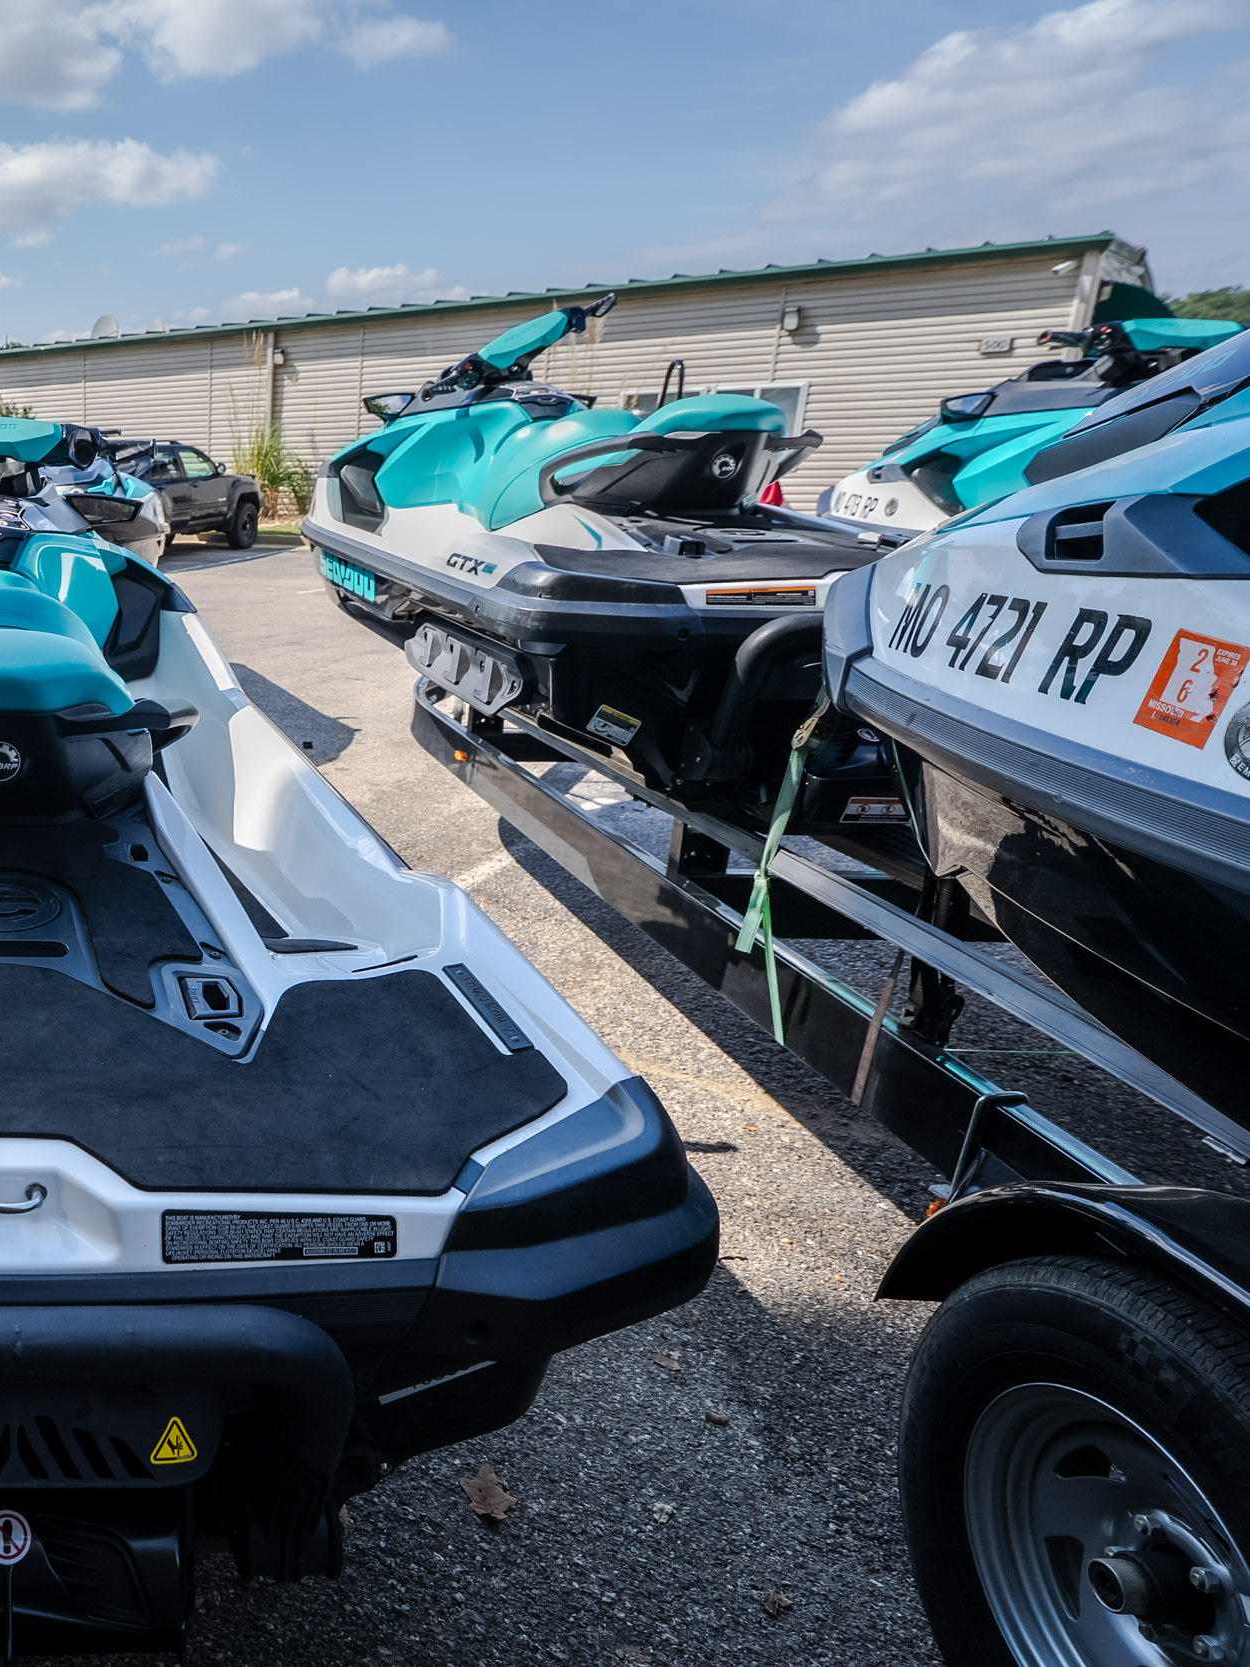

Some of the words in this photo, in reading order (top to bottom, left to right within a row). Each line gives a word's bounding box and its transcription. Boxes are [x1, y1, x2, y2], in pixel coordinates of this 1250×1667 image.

[446, 552, 486, 576] GTX
[888, 583, 950, 658] MO
[946, 592, 1048, 684] 4721
[1037, 608, 1153, 705] RP
[1216, 648, 1242, 660] EXPIRES
[1190, 648, 1209, 674] 2
[1215, 656, 1230, 665] JUNE
[1176, 679, 1194, 703] 6
[1147, 699, 1185, 718] MISSOURI
